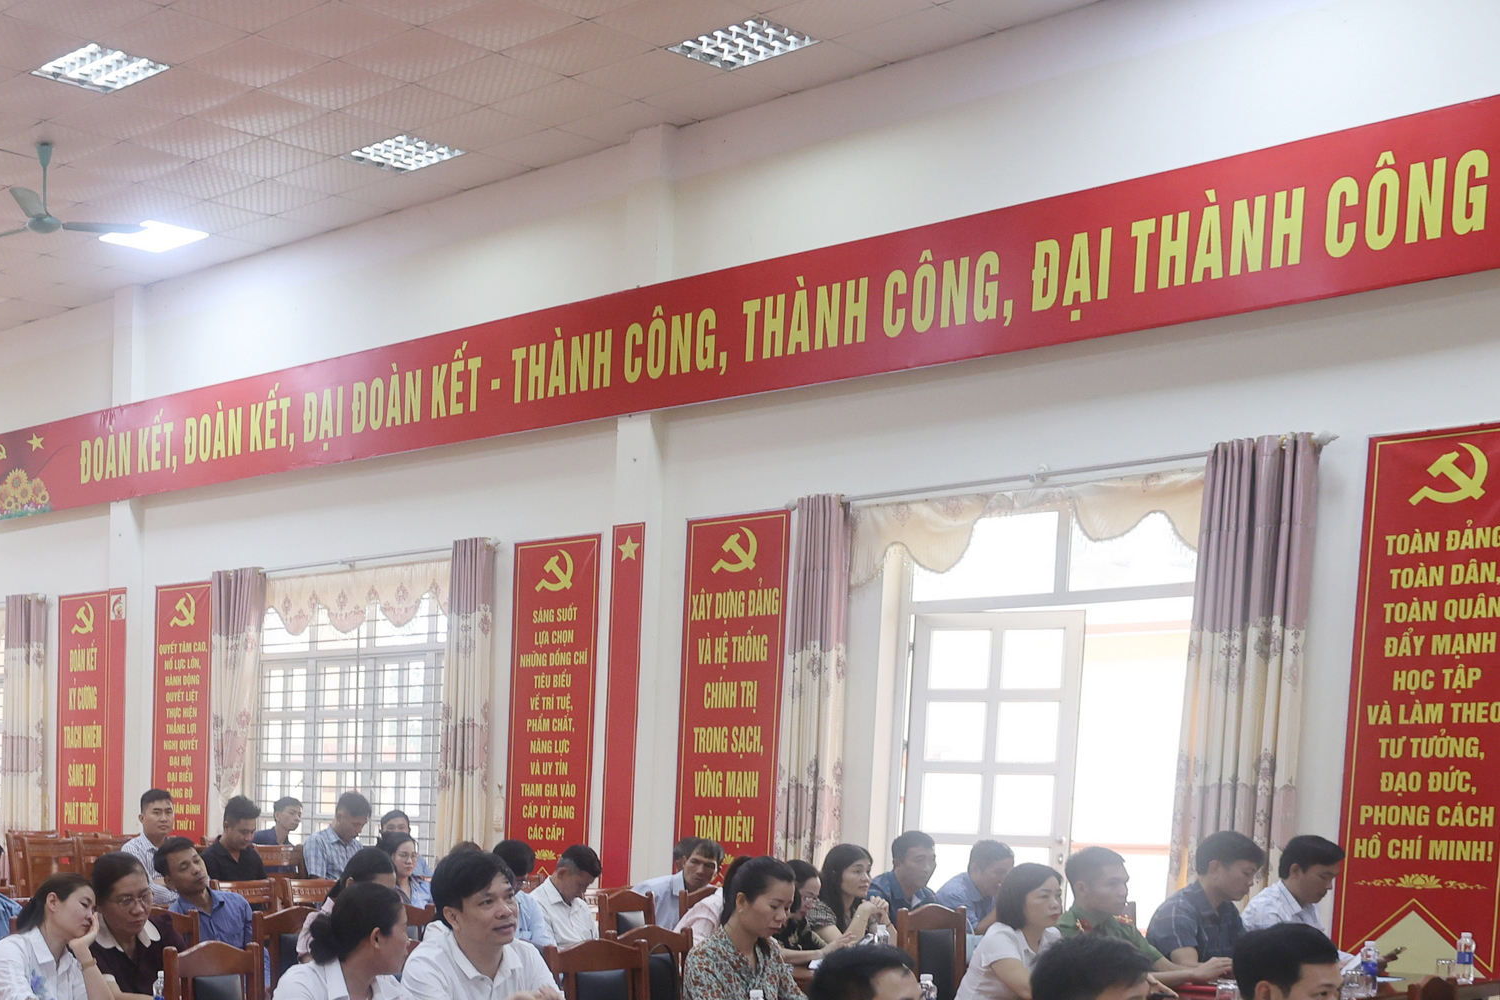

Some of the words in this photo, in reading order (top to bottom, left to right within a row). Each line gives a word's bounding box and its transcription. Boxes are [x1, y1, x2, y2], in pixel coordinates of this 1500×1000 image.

[80, 426, 131, 485] ĐOÀN
[137, 408, 177, 474] KẾT,
[185, 406, 245, 464] ĐOÀN
[249, 385, 294, 453] KẾT,
[303, 387, 342, 451] ĐẠI
[352, 363, 421, 434] ĐOÀN
[430, 342, 482, 419] KẾT
[512, 327, 612, 404] THÀNH
[624, 306, 727, 383] CÔNG,
[743, 276, 868, 362] THÀNH
[882, 250, 1012, 337] CÔNG,
[1031, 227, 1112, 321] ĐẠI
[1131, 189, 1305, 294] THÀNH
[1325, 149, 1489, 258] CÔNG
[1385, 528, 1440, 556] TOÀN
[1390, 562, 1444, 589] TOÀN
[533, 607, 554, 624] SÁNG
[557, 603, 578, 622] SUỐT
[691, 588, 712, 621] XÂY
[715, 590, 744, 624] DỰNG
[748, 577, 779, 616] ĐẢNG
[1383, 597, 1437, 623] TOÀN
[535, 630, 549, 648] LỰA
[552, 629, 574, 646] CHỌN
[698, 634, 711, 665] VÀ
[714, 631, 728, 669] HỆ
[732, 625, 768, 662] THỐNG
[1384, 627, 1425, 657] ĐẨY
[1431, 632, 1496, 659] MẠNH
[520, 652, 547, 668] NHỮNG
[550, 648, 571, 666] ĐỒNG
[574, 648, 587, 664] CHÍ
[534, 672, 550, 688] TIÊU
[553, 669, 571, 688] BIỂU
[1393, 669, 1435, 695] HỌC
[1442, 664, 1482, 693] TẬP
[530, 693, 540, 710] VỀ
[542, 694, 554, 710] TRÍ
[557, 693, 573, 712] TUỆ,
[704, 676, 738, 709] CHÍNH
[740, 681, 757, 713] TRỊ
[527, 714, 549, 732] PHẨM
[552, 712, 574, 733] CHẤT,
[1367, 699, 1394, 725] VÀ
[1398, 699, 1446, 724] LÀM
[530, 738, 552, 754] NĂNG
[555, 739, 570, 756] LỰC
[693, 727, 728, 754] TRONG
[731, 725, 763, 758] SẠCH,
[1379, 737, 1404, 759] TƯ
[1409, 729, 1485, 760] TƯỞNG,
[530, 759, 540, 775] VÀ
[543, 762, 553, 775] UY
[555, 759, 568, 775] TÍN
[1380, 771, 1422, 794] ĐẠO
[1427, 765, 1477, 795] ĐỨC,
[521, 784, 542, 797] THAM
[545, 784, 557, 797] GIA
[560, 781, 576, 797] VÀO
[694, 765, 722, 798] VỮNG
[726, 771, 759, 803] MẠNH
[523, 800, 538, 818] CẤP
[540, 800, 551, 818] UỶ
[553, 800, 574, 819] ĐẢNG
[1359, 806, 1430, 827] PHONG
[1436, 801, 1495, 827] CÁCH
[528, 824, 543, 840] CÁC
[546, 822, 564, 841] CẤP!
[694, 810, 722, 842] TOÀN
[724, 810, 754, 848] DIỆN!
[1354, 830, 1382, 859] HỒ
[1388, 835, 1424, 859] CHÍ
[1428, 838, 1494, 862] MINH!
